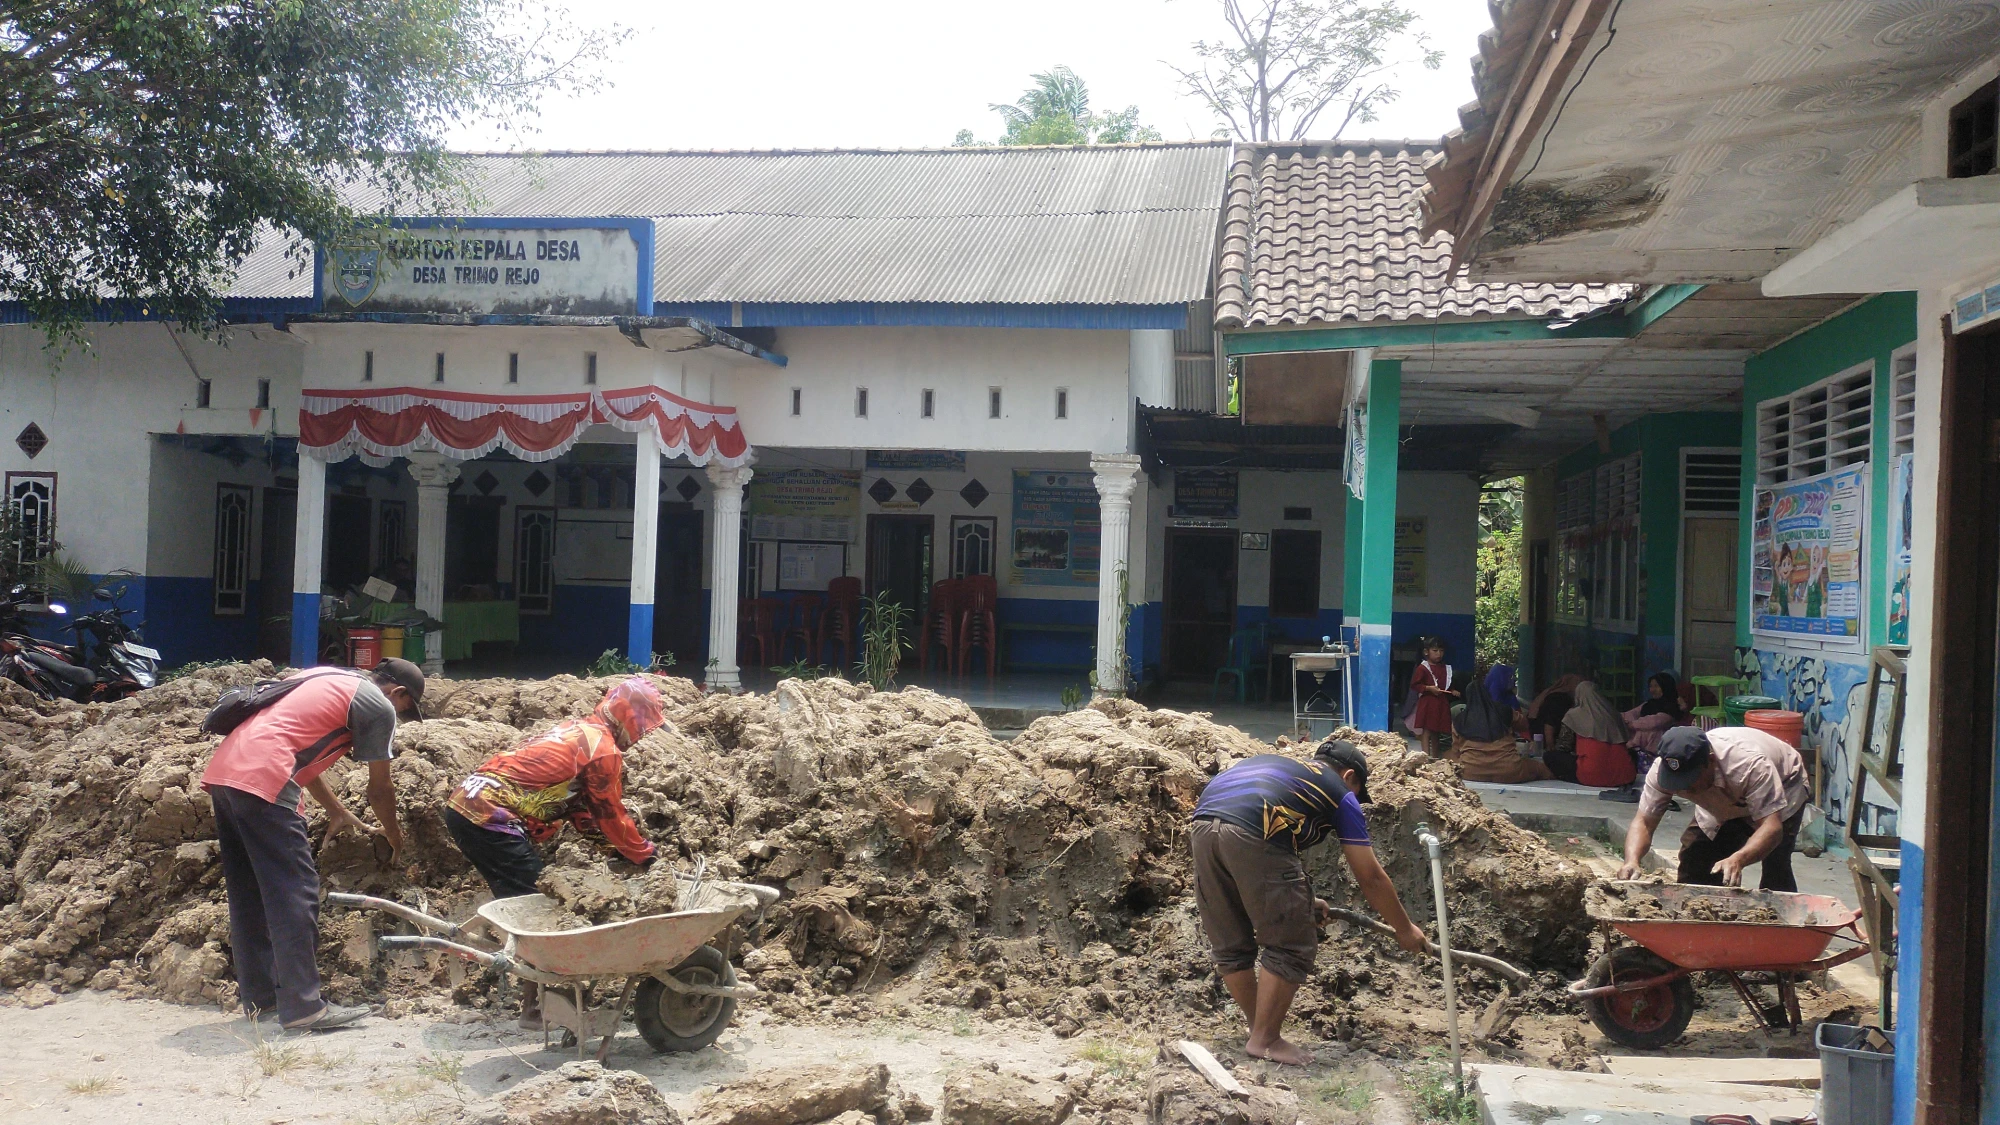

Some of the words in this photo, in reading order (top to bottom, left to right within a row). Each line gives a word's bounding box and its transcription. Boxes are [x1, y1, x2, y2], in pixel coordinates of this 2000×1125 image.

[461, 239, 526, 261] KEPALA
[536, 240, 581, 261] DESA
[413, 266, 447, 284] DESA
[454, 266, 499, 285] TRIMO
[505, 267, 540, 285] REJO
[795, 486, 815, 494] TRIMO
[1178, 487, 1195, 497] DESA
[1197, 487, 1217, 497] TRIMO
[1218, 488, 1235, 497] REJO
[1817, 528, 1831, 540] REJO
